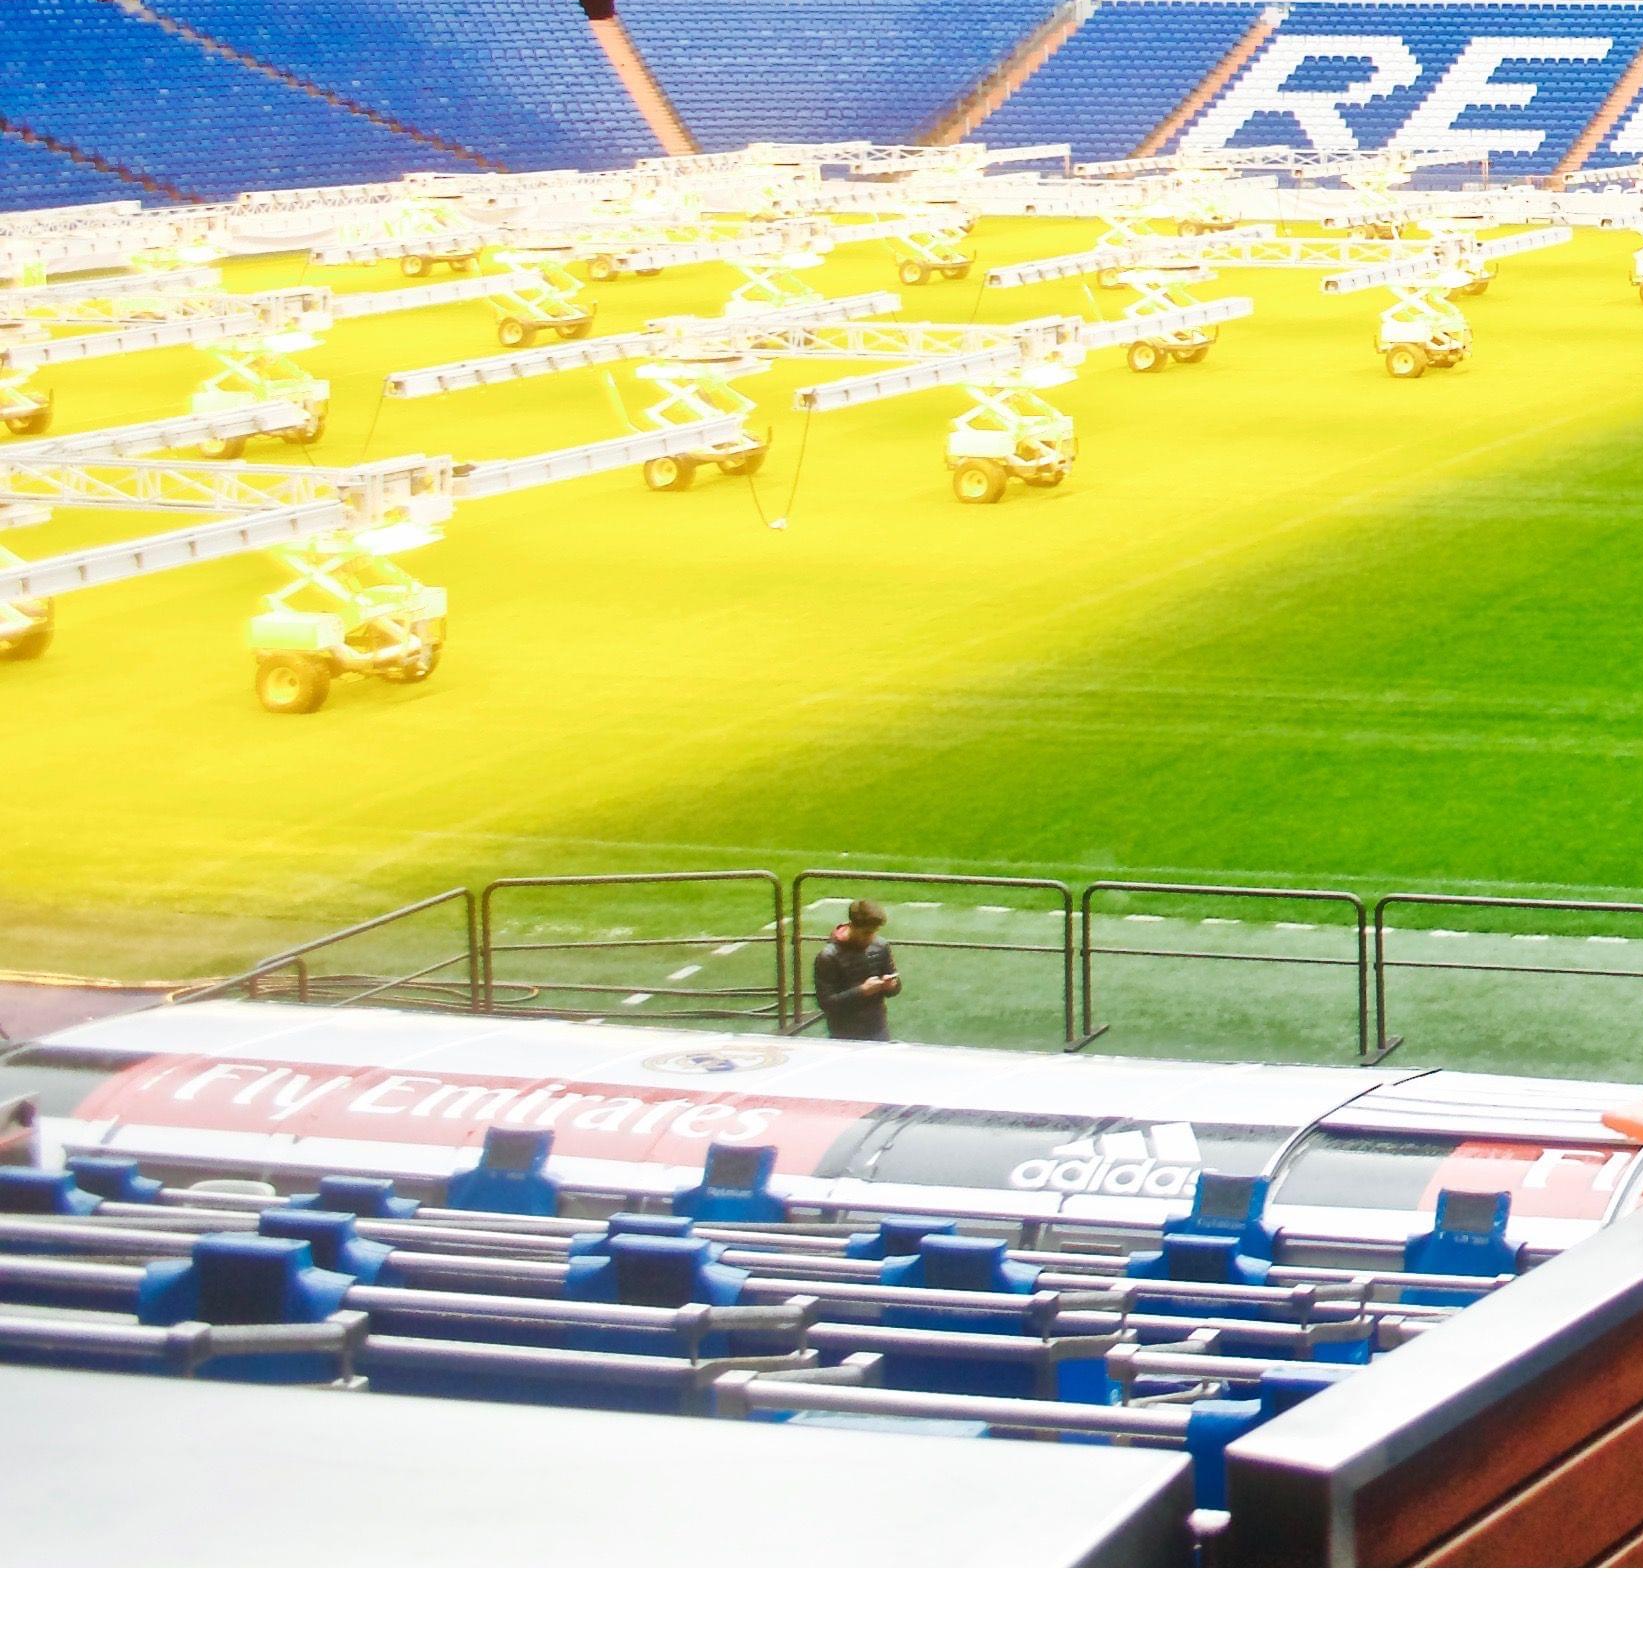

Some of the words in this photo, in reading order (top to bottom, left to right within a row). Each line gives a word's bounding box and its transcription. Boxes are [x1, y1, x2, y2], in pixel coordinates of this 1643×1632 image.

[171, 1064, 354, 1116] Fly
[348, 1073, 786, 1143] Emirates
[1522, 1147, 1635, 1192] Fl
